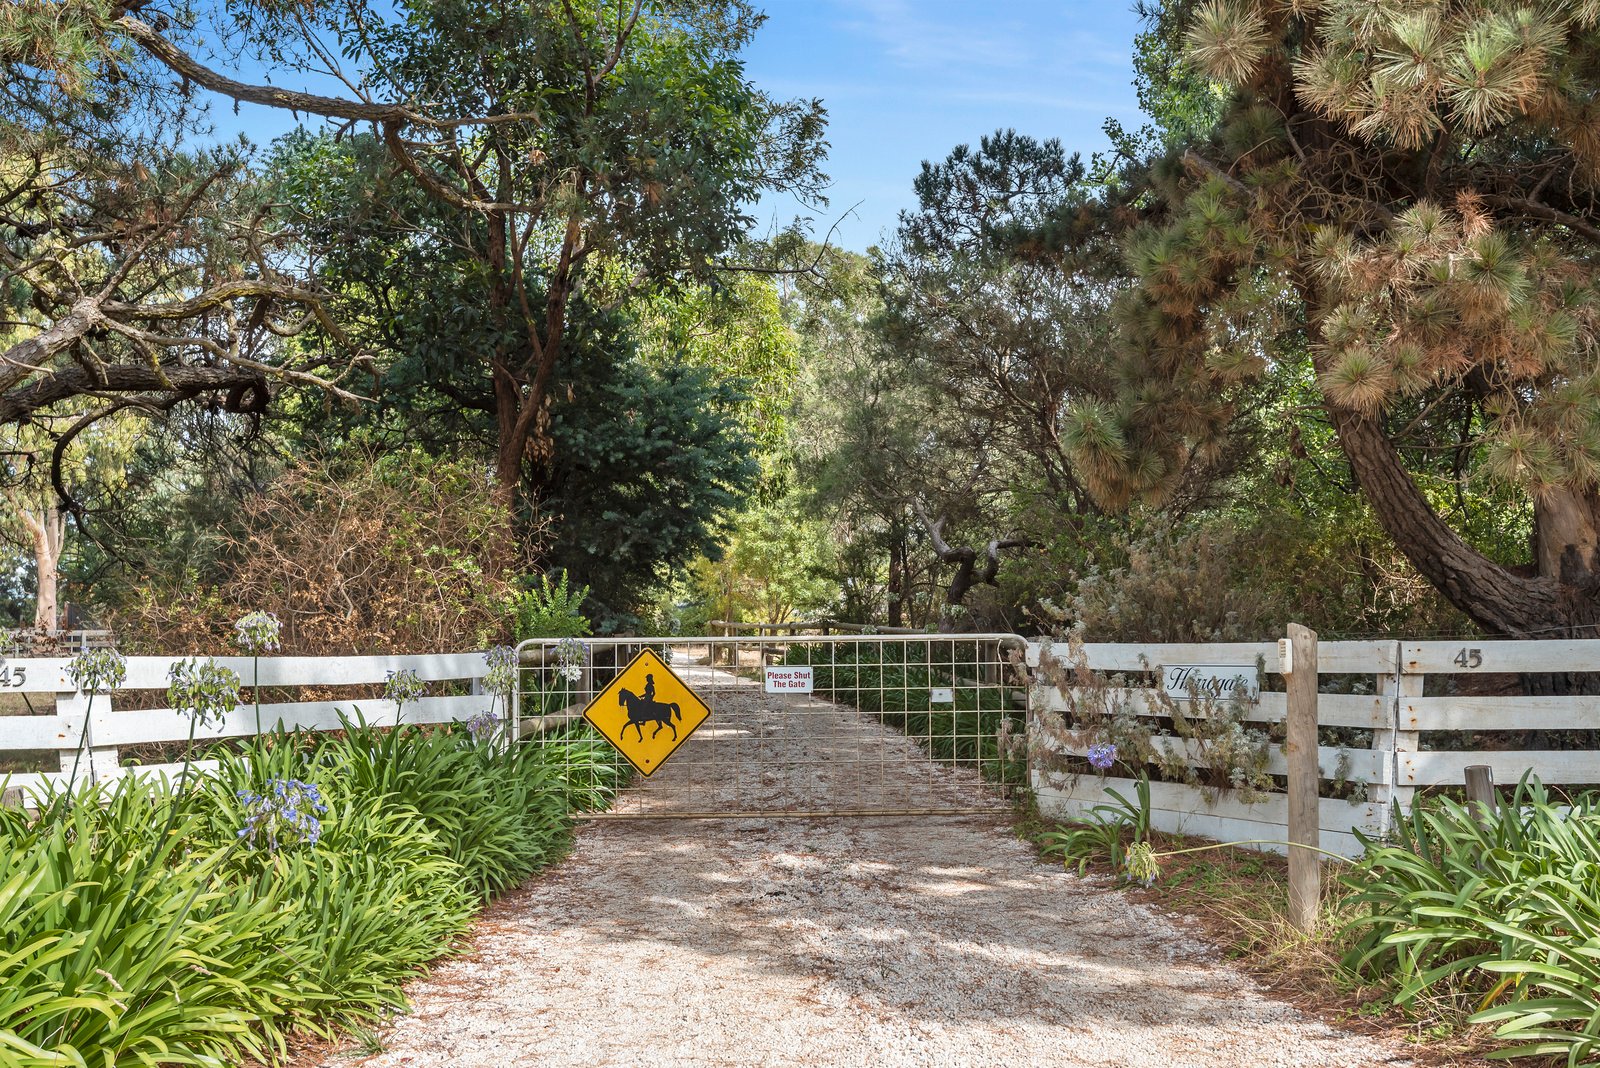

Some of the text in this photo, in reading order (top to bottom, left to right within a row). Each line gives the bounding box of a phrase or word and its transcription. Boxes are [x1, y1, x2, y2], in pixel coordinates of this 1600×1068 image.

[1453, 647, 1482, 668] 45
[0, 666, 26, 687] 45
[767, 671, 811, 679] Please Shut
[773, 680, 806, 688] The Gate
